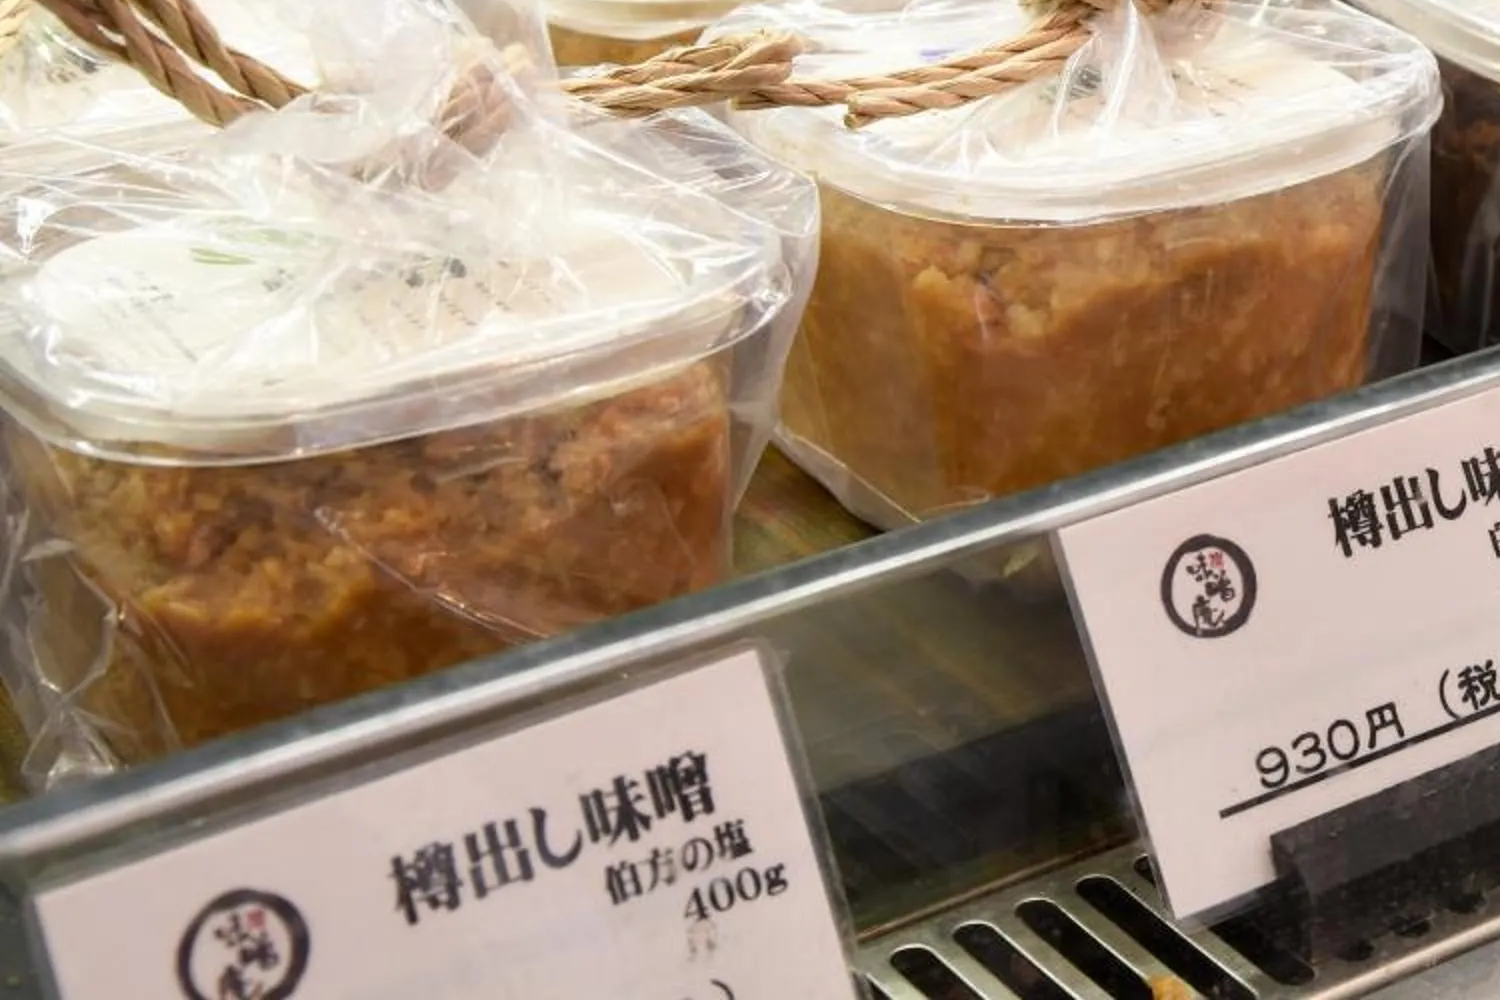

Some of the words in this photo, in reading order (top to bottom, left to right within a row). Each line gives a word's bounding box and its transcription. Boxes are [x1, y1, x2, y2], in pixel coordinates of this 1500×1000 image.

[1255, 702, 1406, 789] 930円
[389, 750, 716, 926] 樽出し味噌
[605, 819, 754, 905] 伯方の塩
[684, 863, 789, 921] 400g
